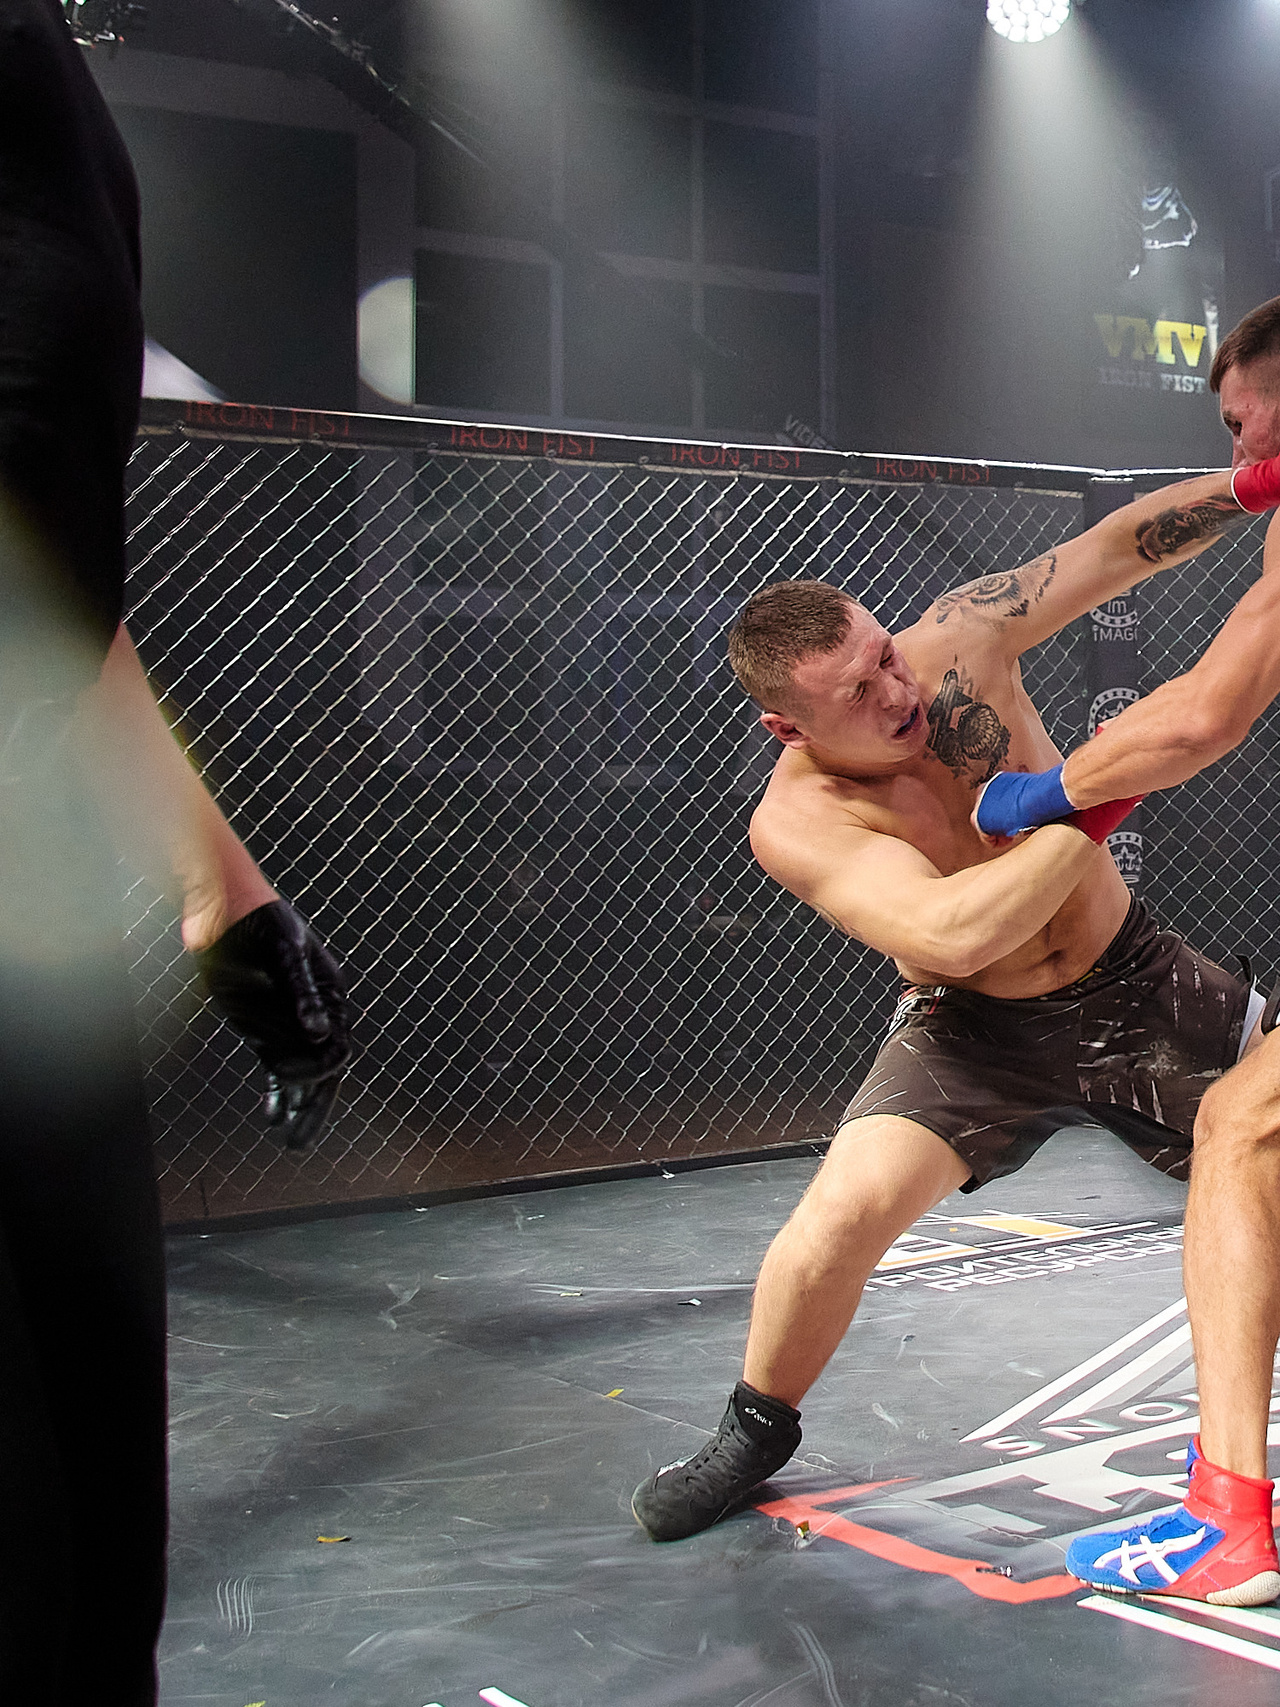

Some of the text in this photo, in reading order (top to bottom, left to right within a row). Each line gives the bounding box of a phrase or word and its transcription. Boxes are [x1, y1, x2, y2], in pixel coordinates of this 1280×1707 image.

[1160, 373, 1206, 393] FIST
[451, 426, 528, 451] IRON
[671, 444, 740, 467] IRON
[875, 459, 937, 480] IRON
